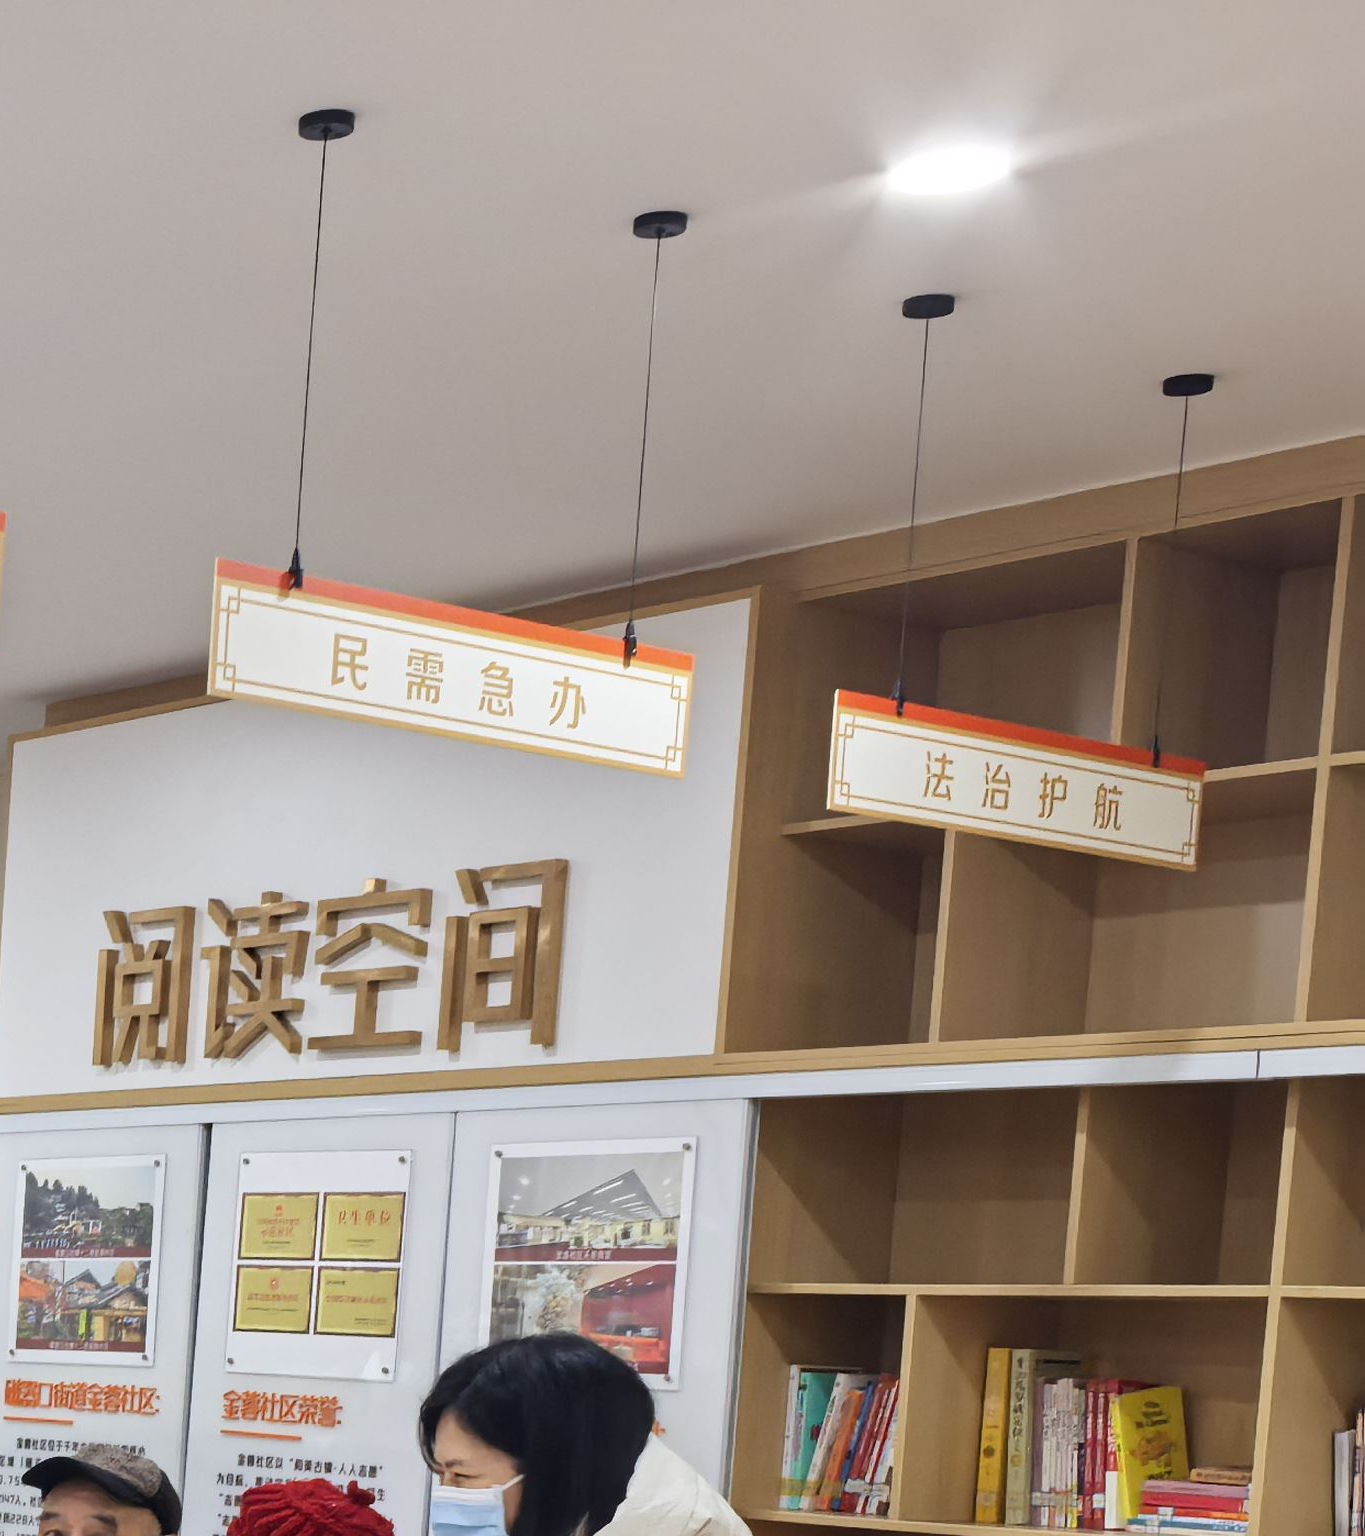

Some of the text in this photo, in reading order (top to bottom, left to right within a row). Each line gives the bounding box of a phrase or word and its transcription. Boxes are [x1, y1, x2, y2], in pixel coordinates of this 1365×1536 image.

[330, 633, 587, 729] 民需急办
[922, 751, 1125, 832] 法治护航
[92, 858, 570, 1068] 阅读空间
